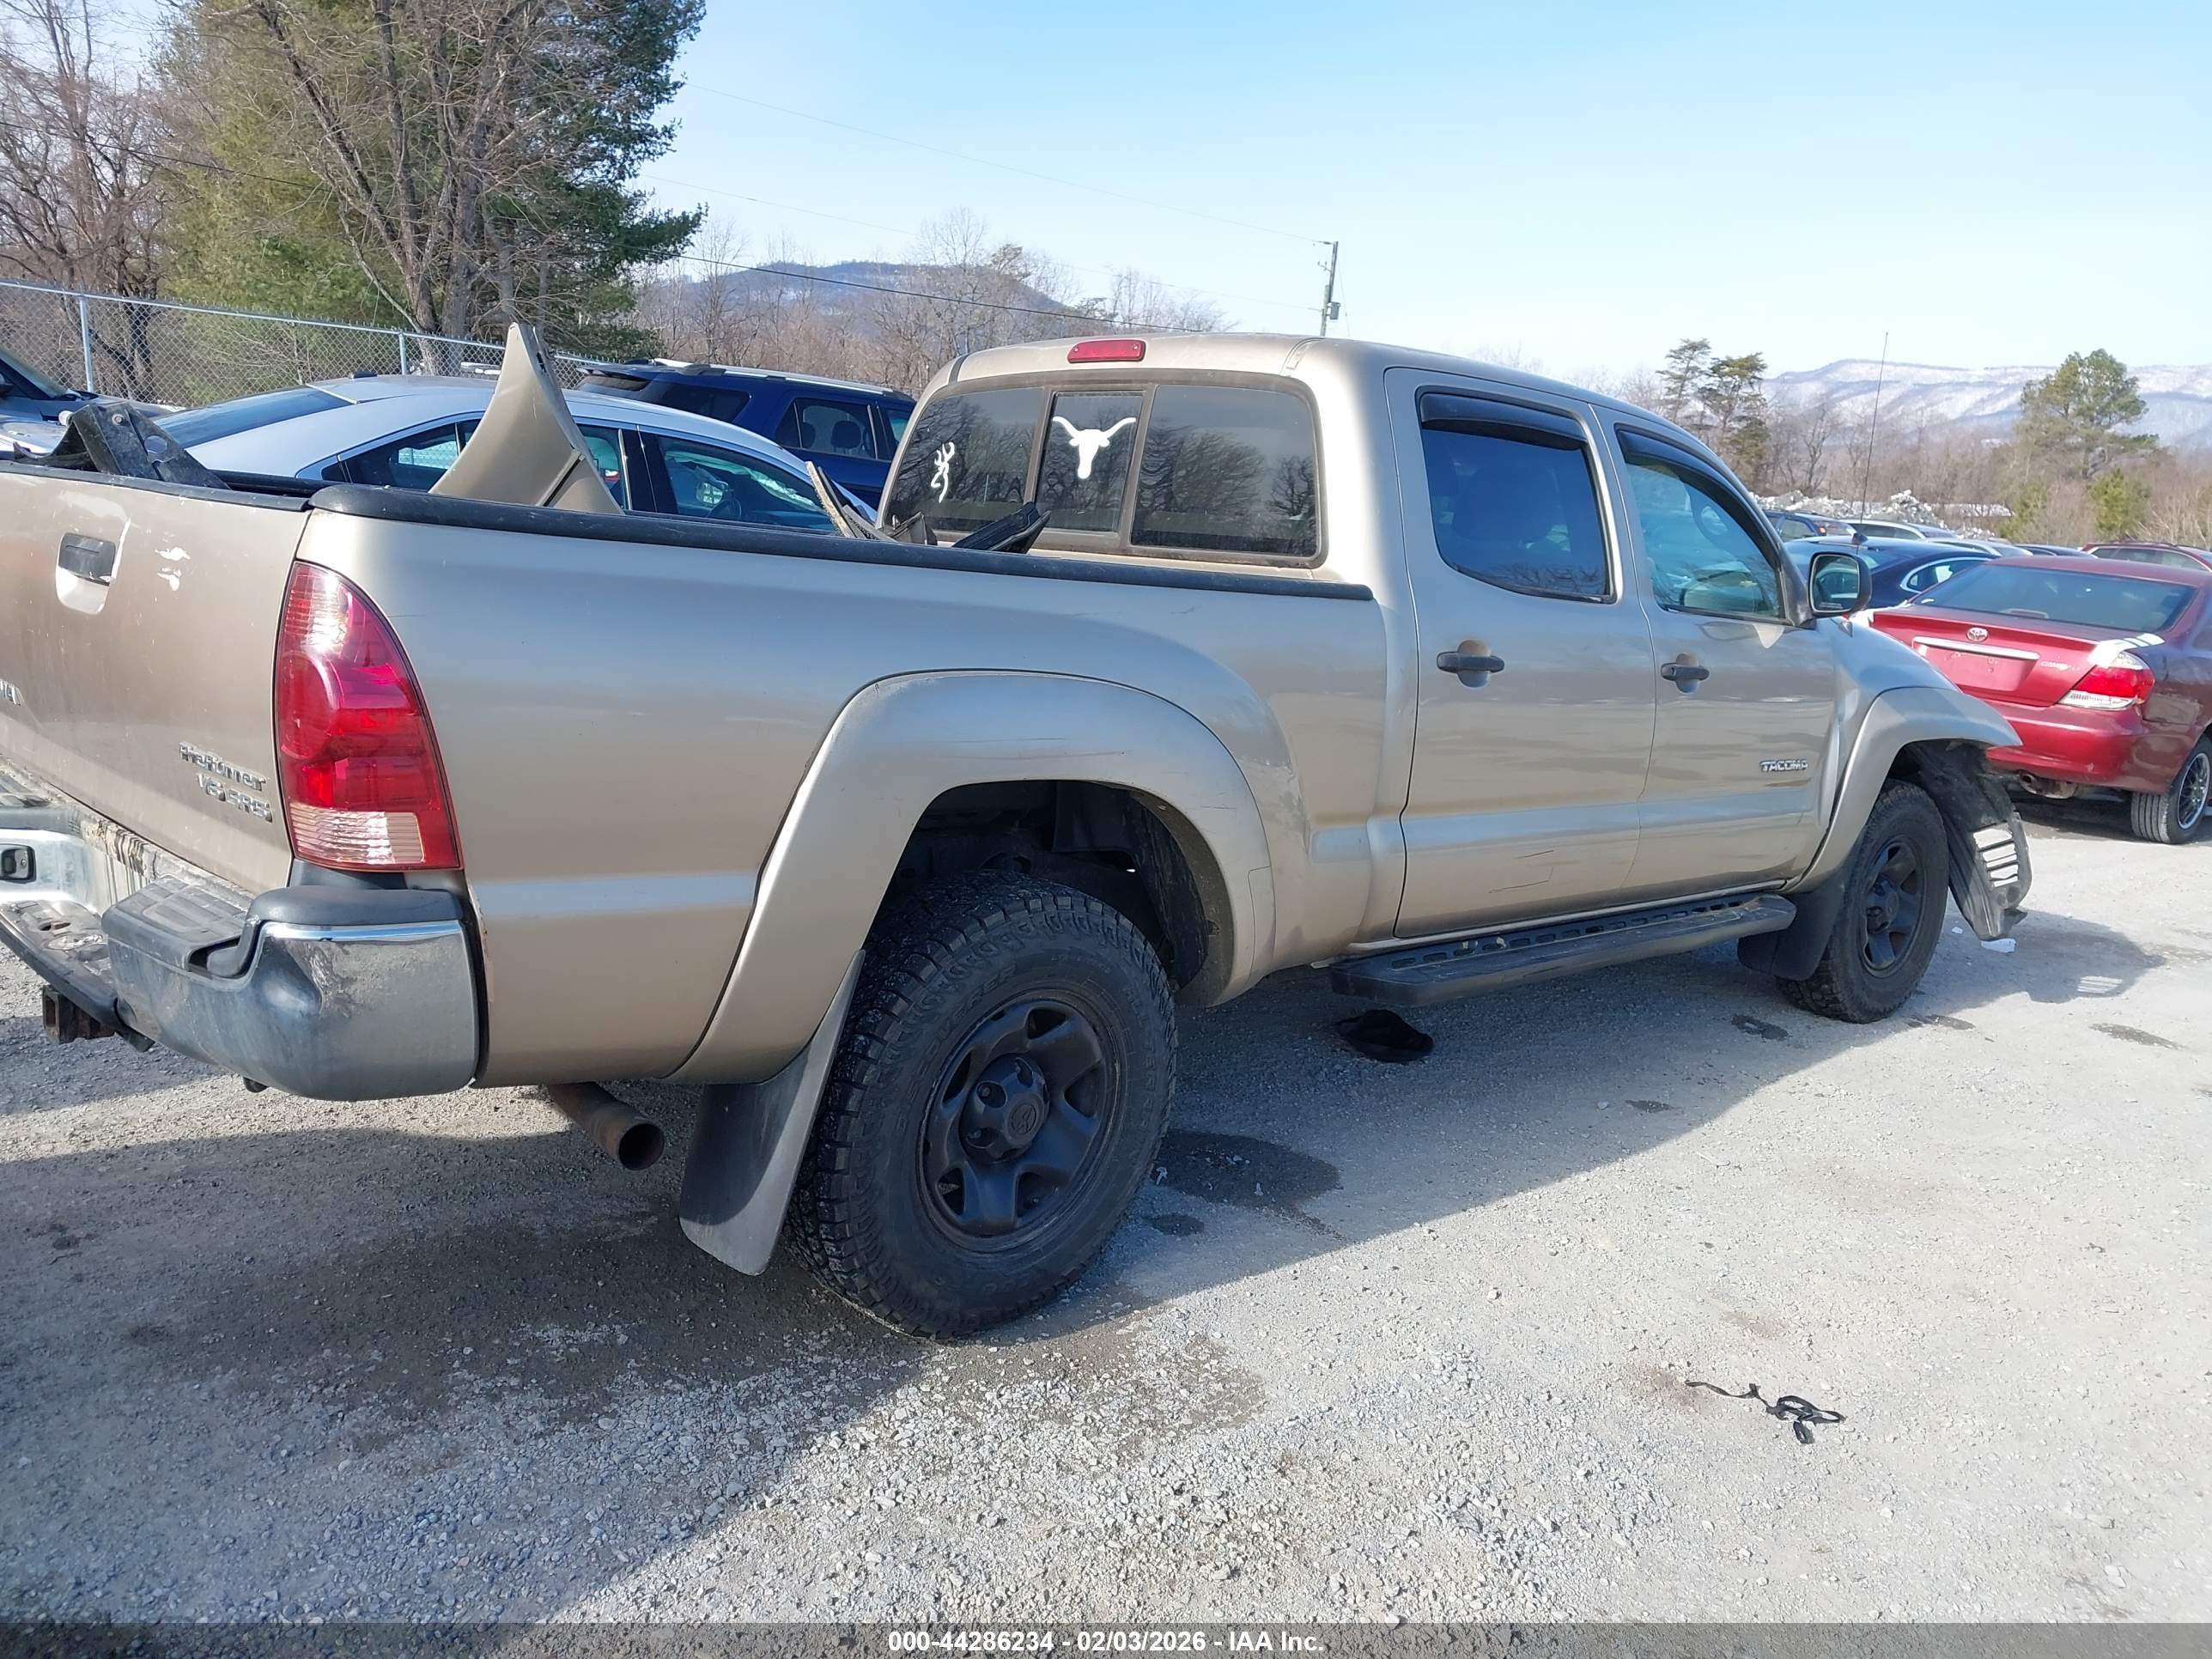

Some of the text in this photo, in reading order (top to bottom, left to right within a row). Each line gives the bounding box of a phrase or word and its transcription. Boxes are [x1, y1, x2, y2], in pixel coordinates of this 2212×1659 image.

[1759, 759, 1808, 773] TACOMA
[196, 773, 273, 823] V6 SR5
